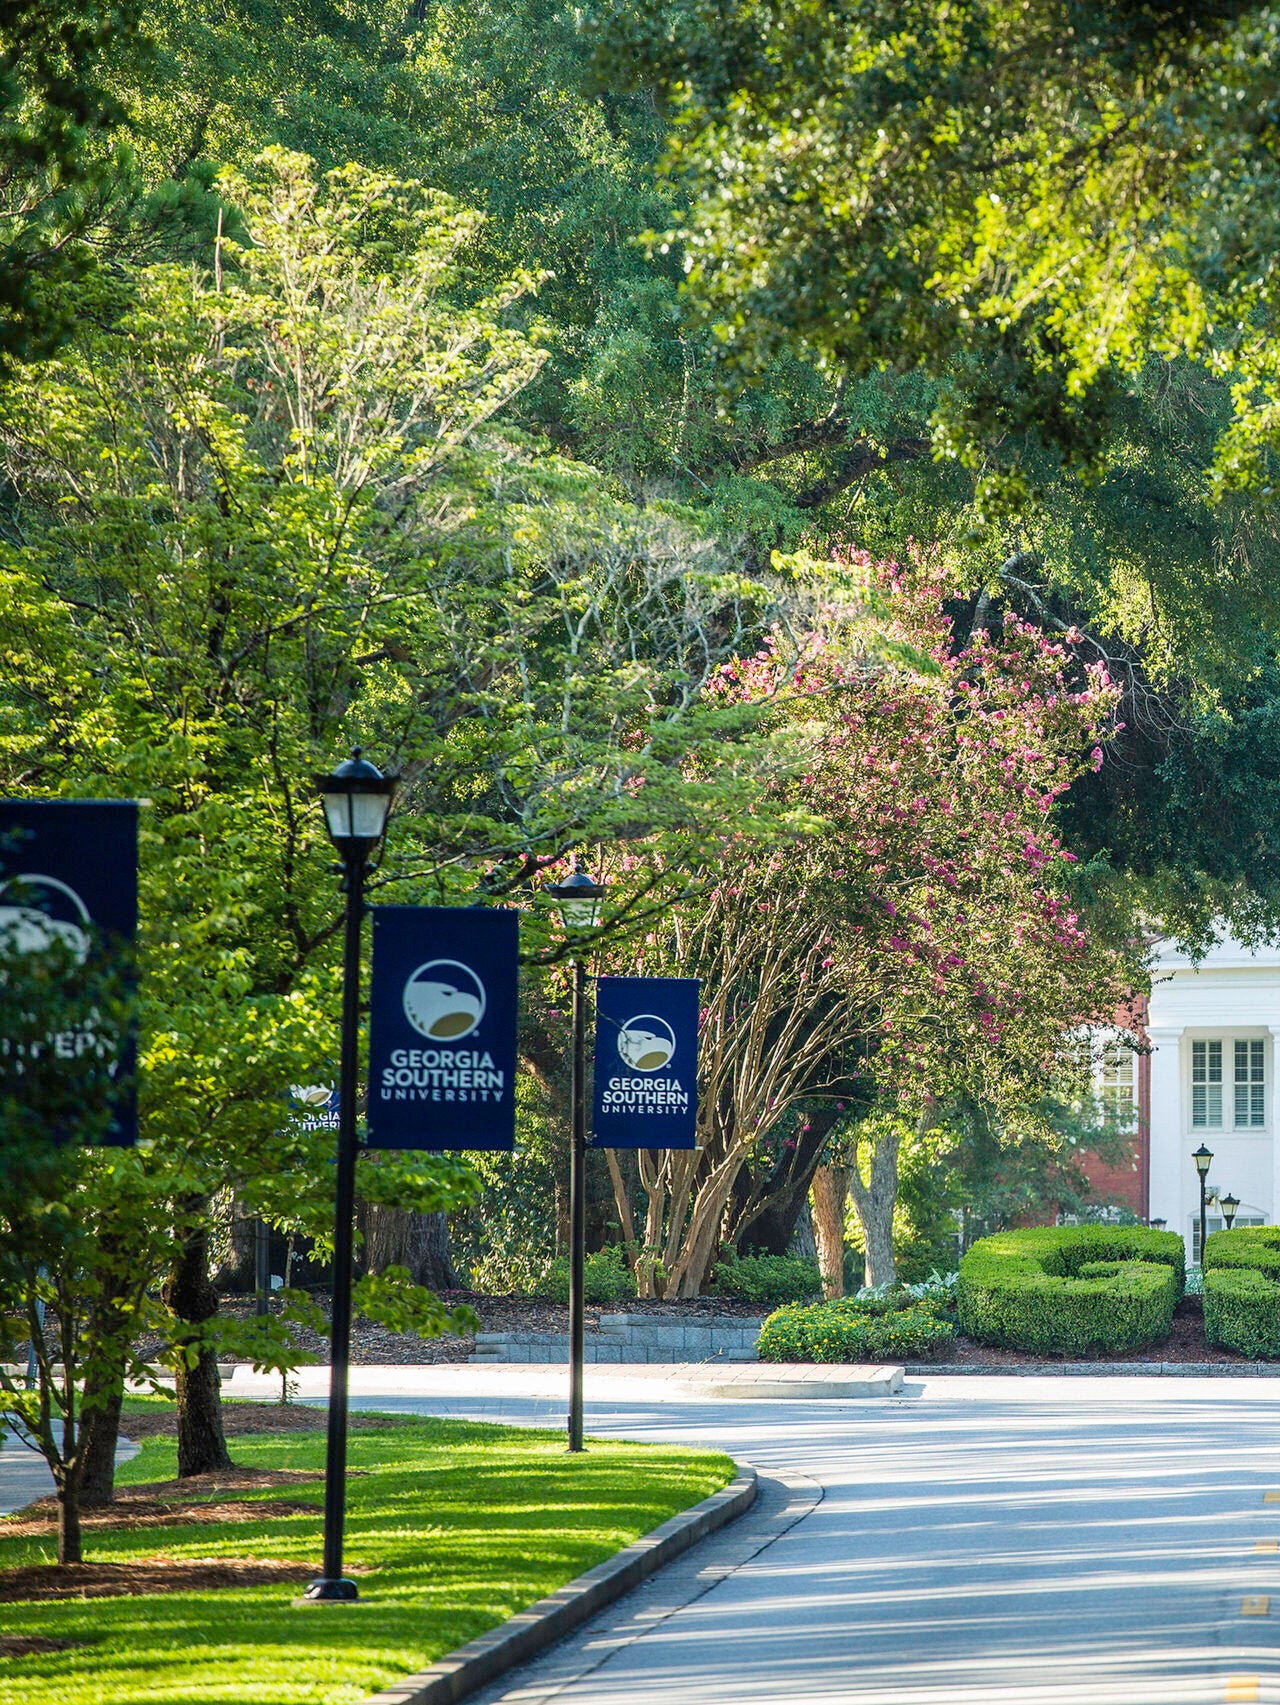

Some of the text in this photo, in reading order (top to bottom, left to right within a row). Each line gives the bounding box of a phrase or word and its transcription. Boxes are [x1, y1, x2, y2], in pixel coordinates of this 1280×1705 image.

[390, 1049, 496, 1069] GEORGIA
[381, 1068, 504, 1088] SOUTHERN
[608, 1077, 682, 1091] GEORGIA
[380, 1088, 504, 1102] UNIVERSITY
[602, 1091, 689, 1105] SOUTHERN
[601, 1105, 689, 1114] UNIVERSITY
